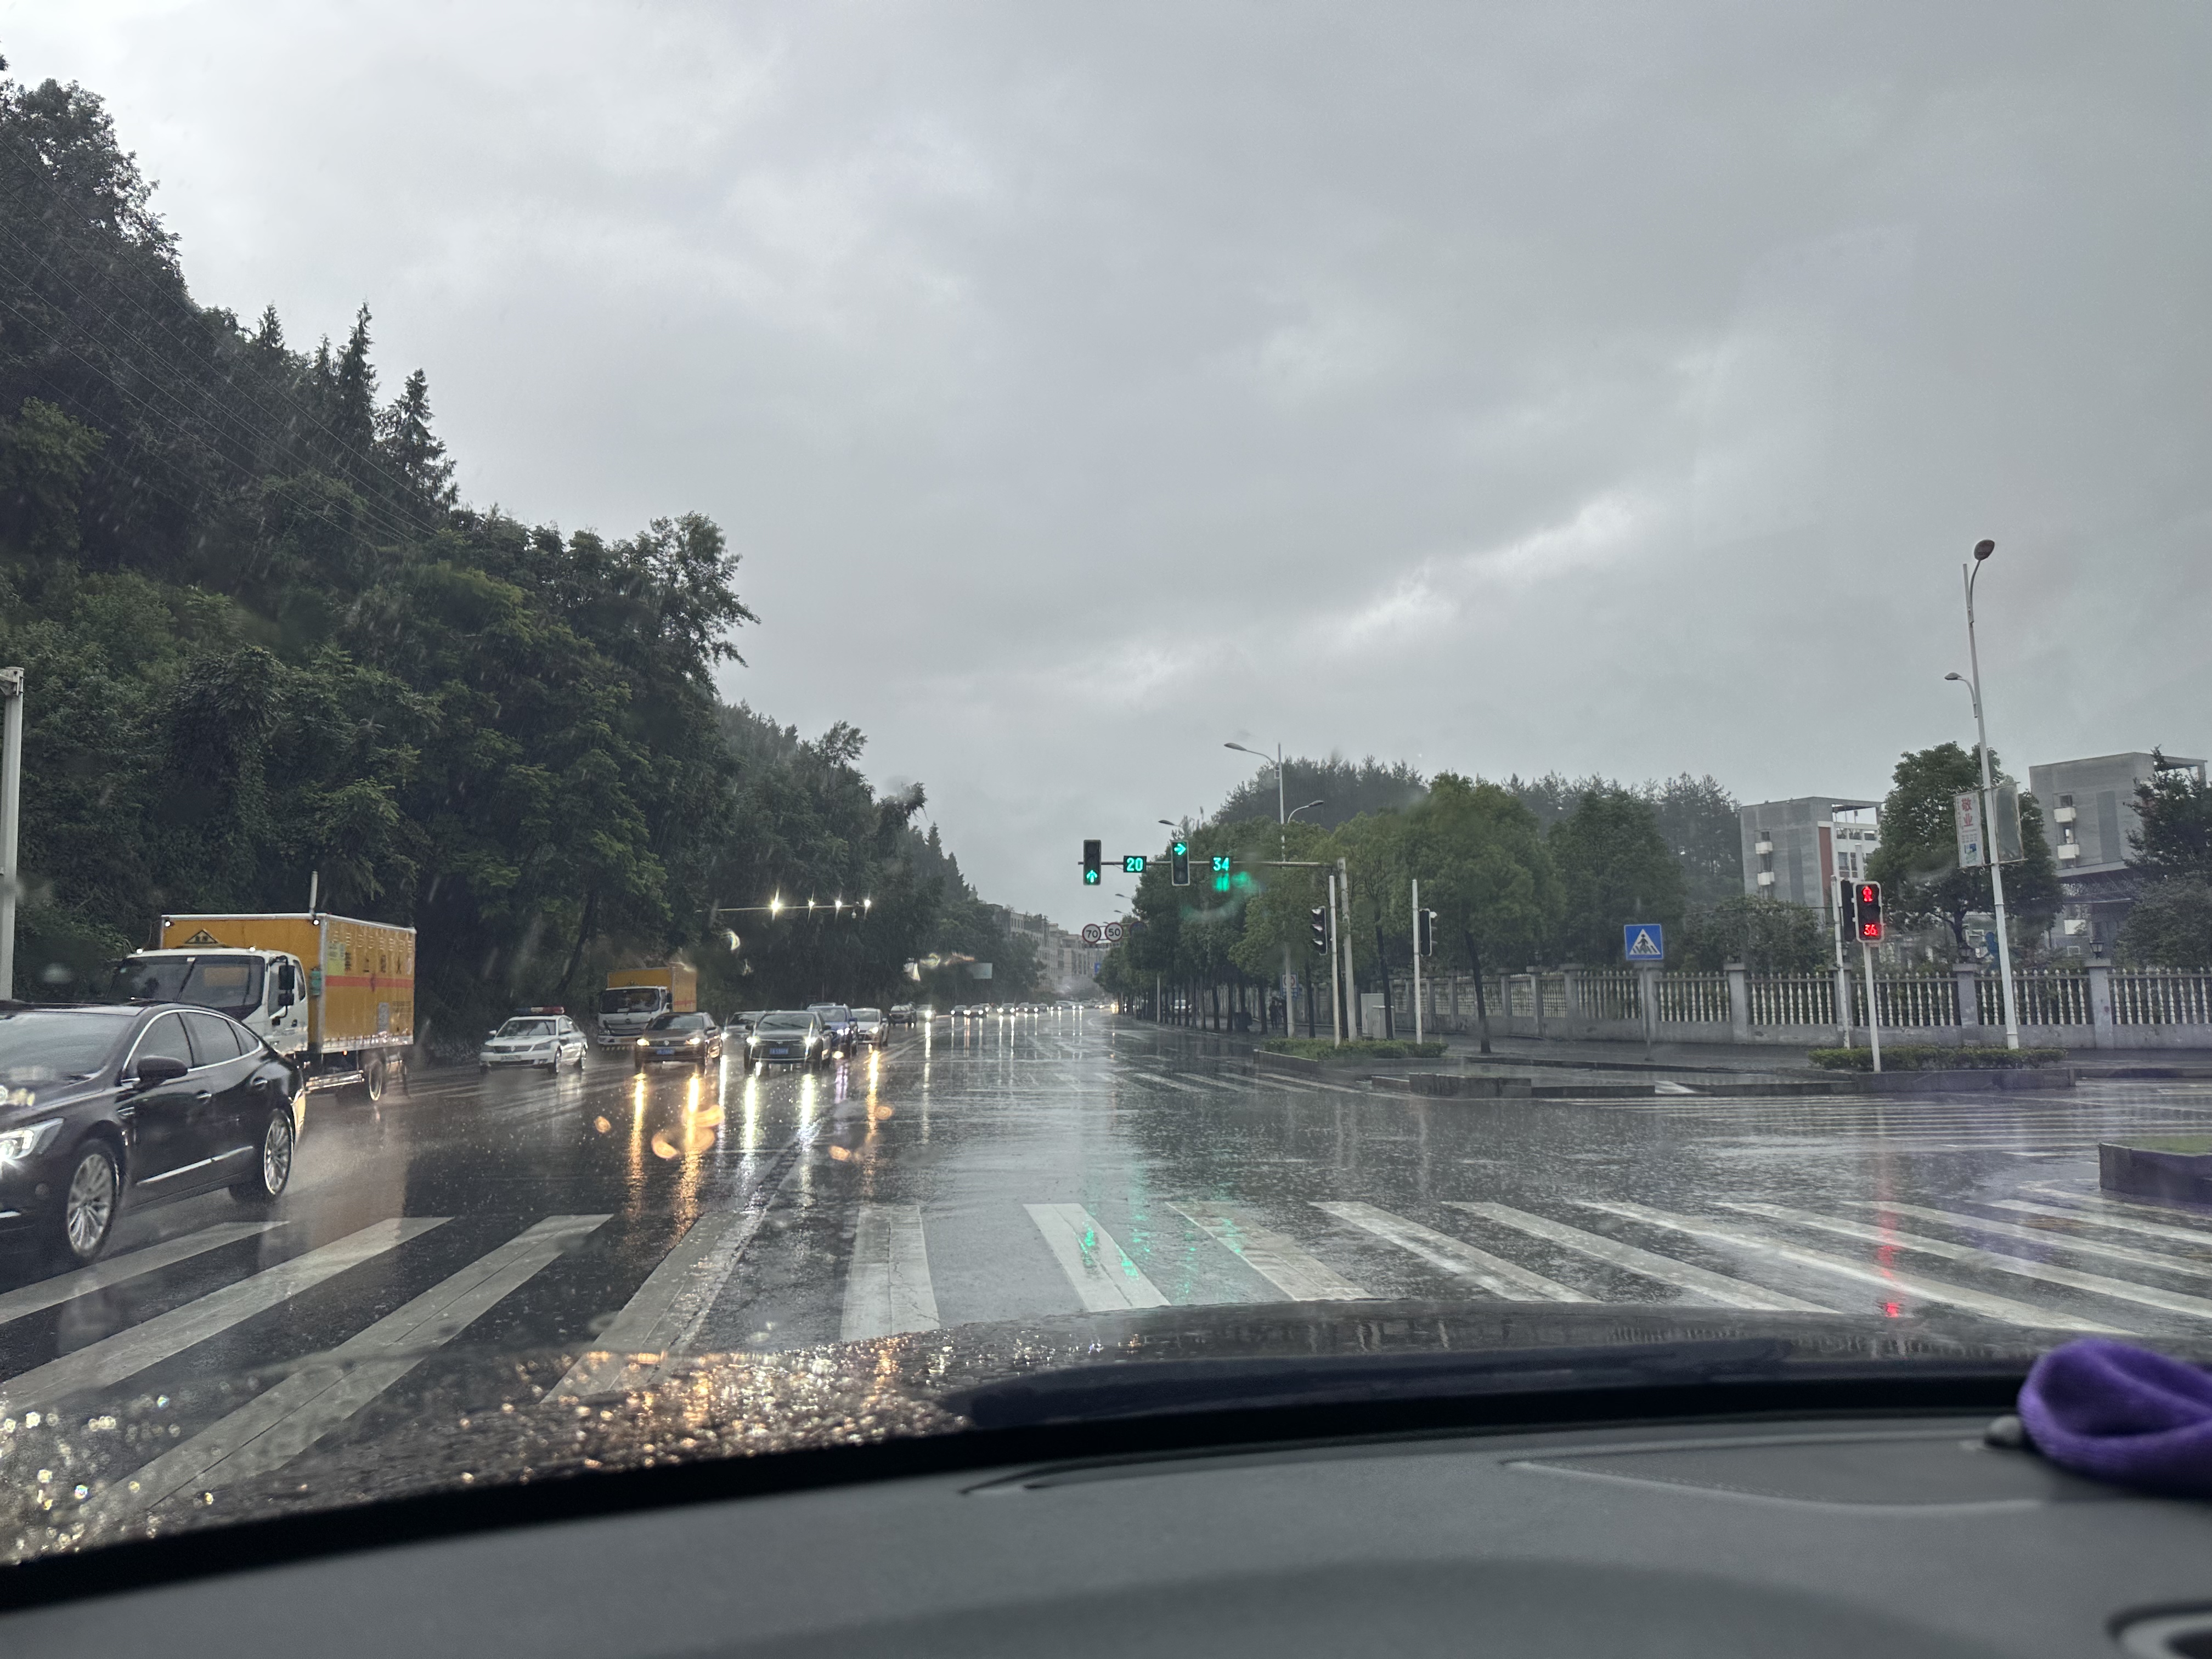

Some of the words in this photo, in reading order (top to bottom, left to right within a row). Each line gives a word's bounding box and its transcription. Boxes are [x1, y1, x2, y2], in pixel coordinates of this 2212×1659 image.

[1961, 797, 1974, 827] 敬业
[1126, 857, 1144, 872] 20
[1213, 857, 1229, 871] 34
[1086, 930, 1098, 938] 70
[1108, 928, 1120, 936] 50
[1864, 924, 1877, 936] 36
